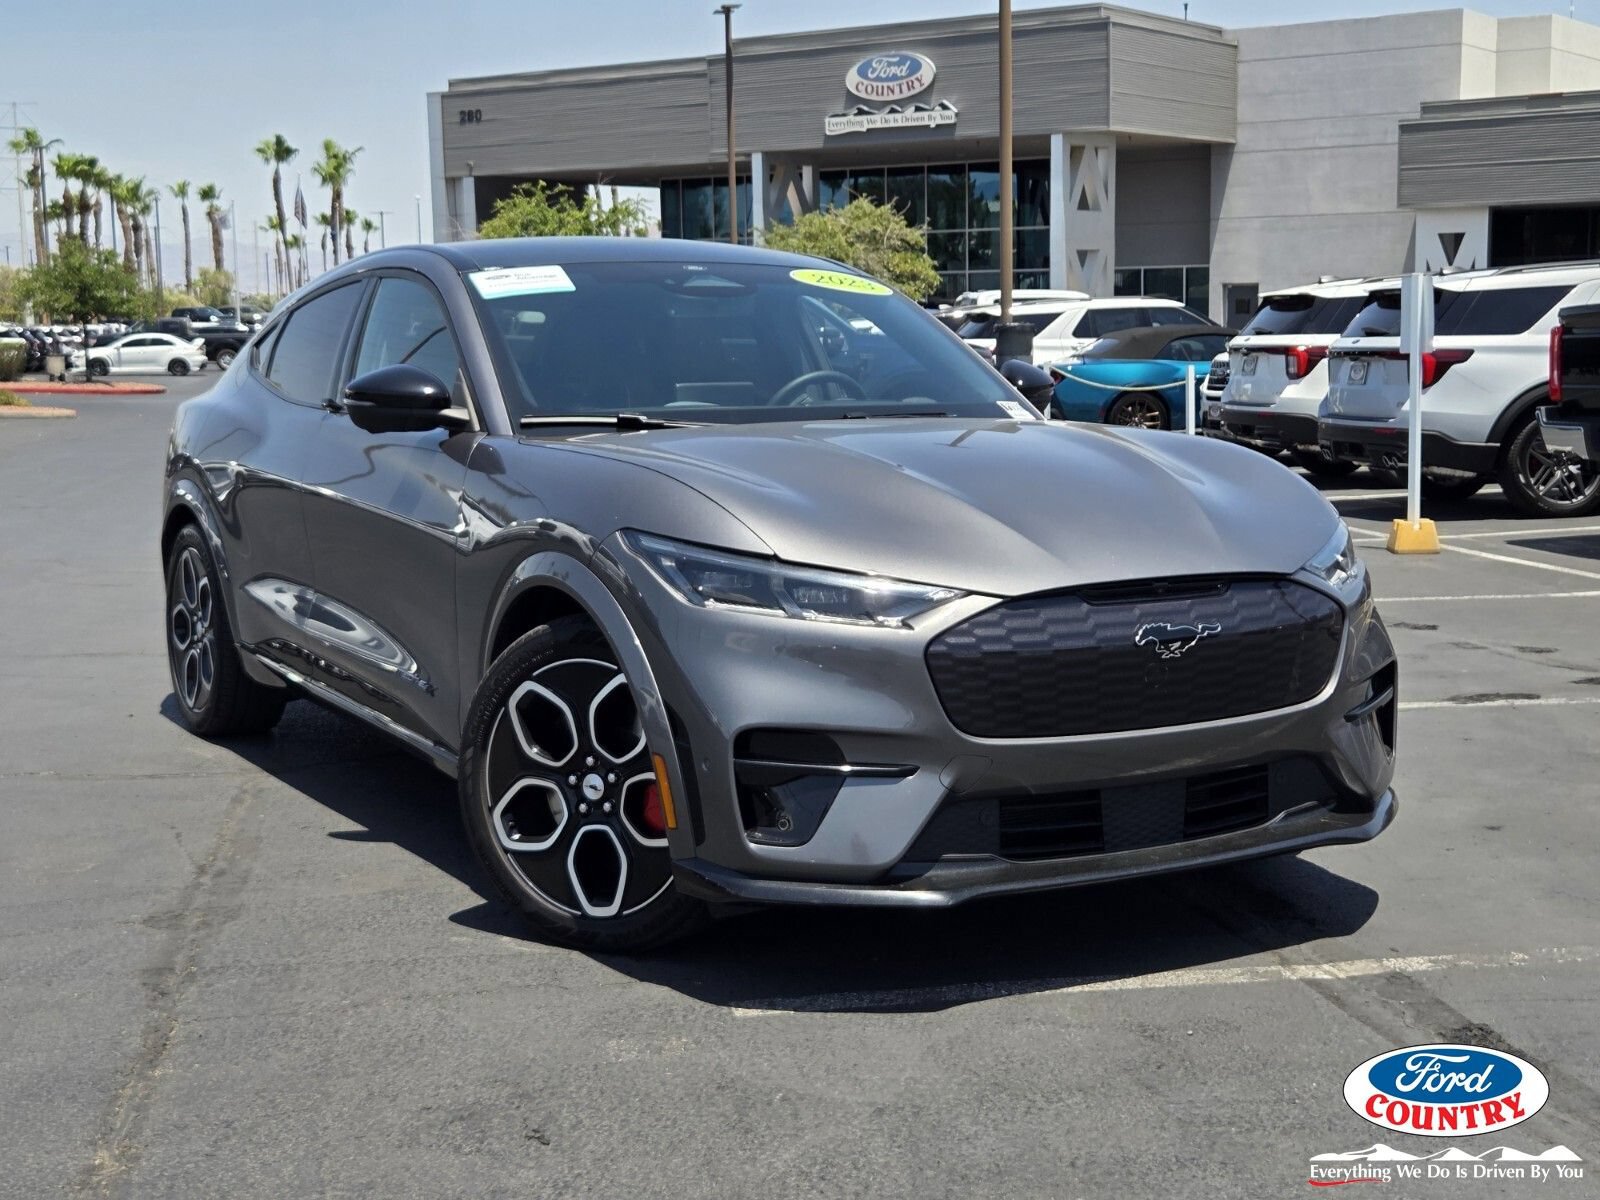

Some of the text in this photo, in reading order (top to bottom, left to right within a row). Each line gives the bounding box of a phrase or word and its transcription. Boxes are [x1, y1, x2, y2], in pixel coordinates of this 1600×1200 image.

[867, 56, 911, 79] Ford
[855, 76, 925, 97] COUNTRY
[827, 111, 953, 129] Everything We Do Is Driven By You
